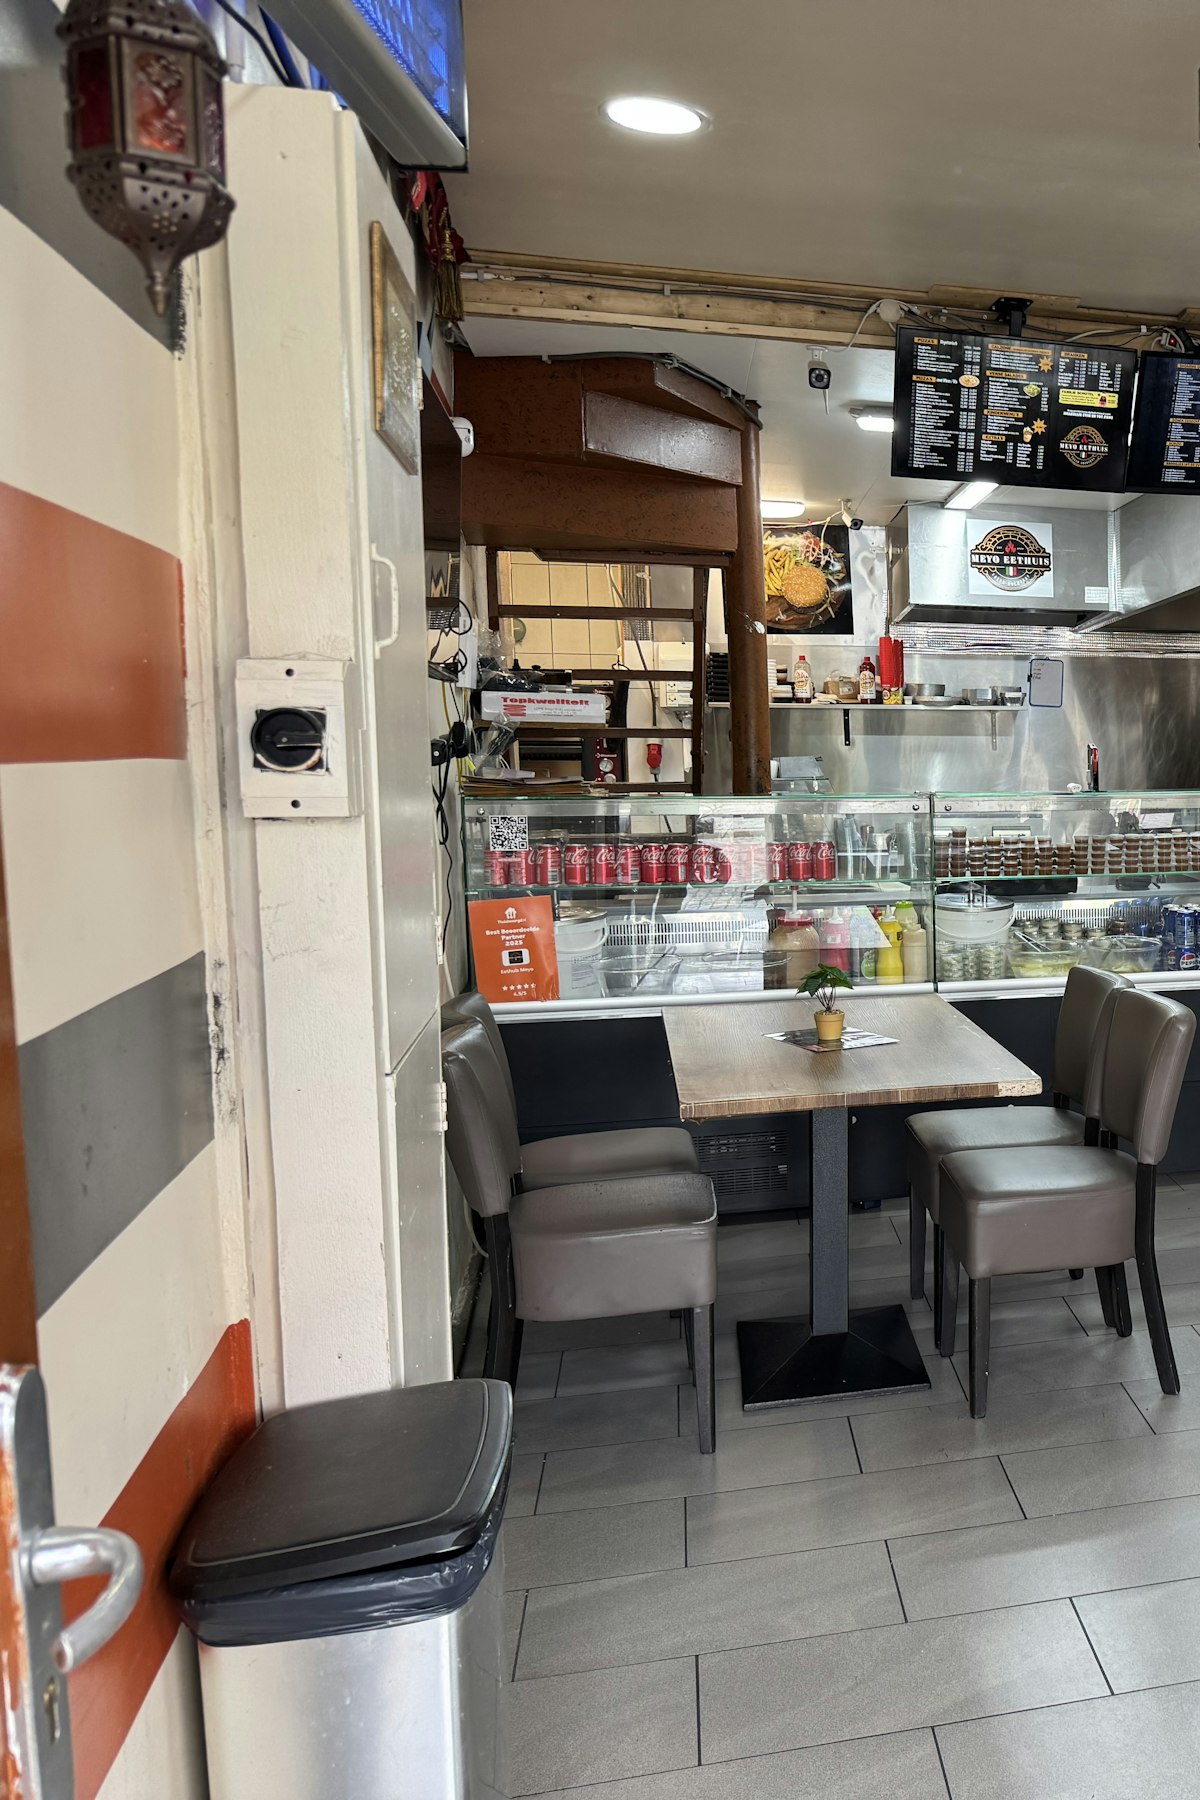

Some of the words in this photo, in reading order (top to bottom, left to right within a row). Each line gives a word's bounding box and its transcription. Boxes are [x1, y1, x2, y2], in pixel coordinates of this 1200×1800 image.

[1079, 444, 1109, 452] EETHUIS
[971, 554, 1000, 564] MEYO
[1003, 555, 1050, 566] EETHUIS
[501, 926, 540, 936] Beoordeelde
